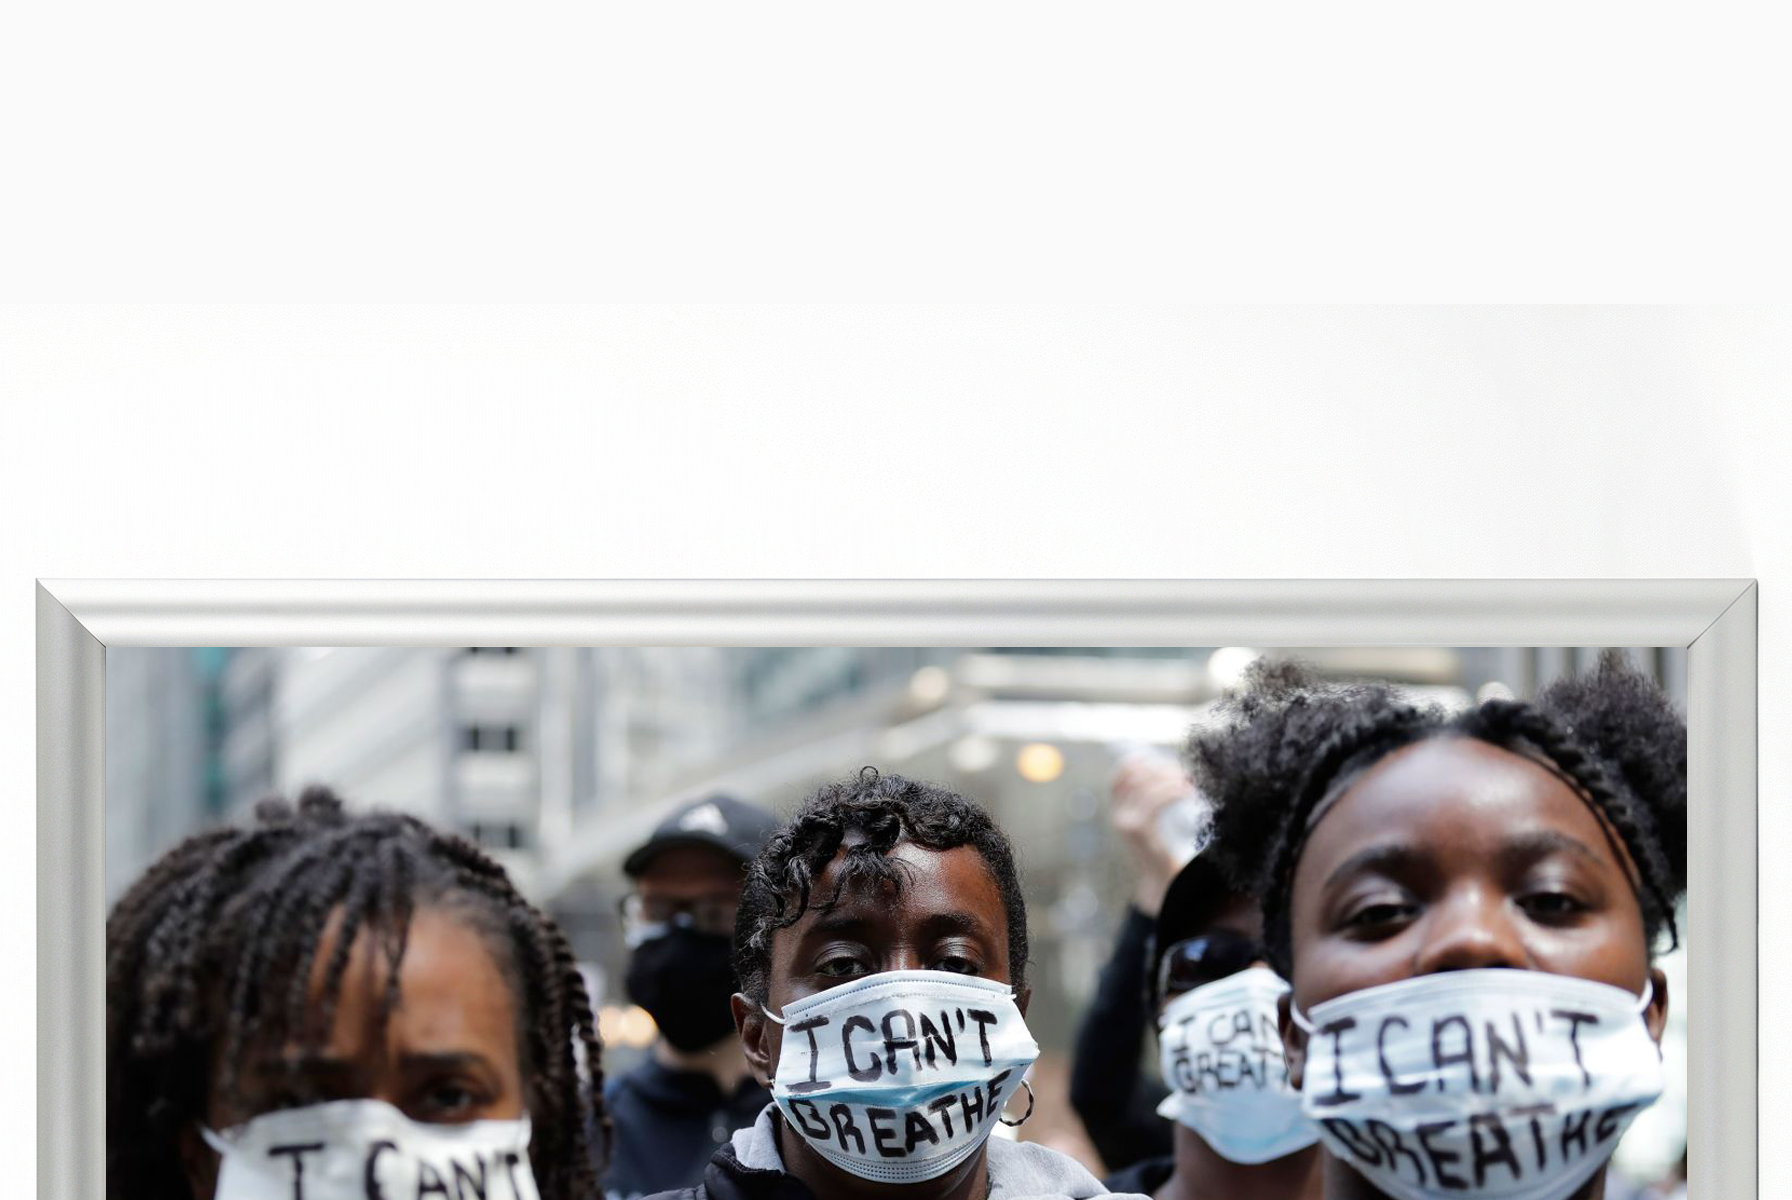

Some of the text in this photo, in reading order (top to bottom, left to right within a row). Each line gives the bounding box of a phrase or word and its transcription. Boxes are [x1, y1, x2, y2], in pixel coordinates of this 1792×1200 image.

[786, 1007, 998, 1093] I CAN'T
[1312, 1010, 1600, 1106] I CAN'T
[787, 1068, 1012, 1158] BREATHE
[1318, 1102, 1640, 1190] BREATHE
